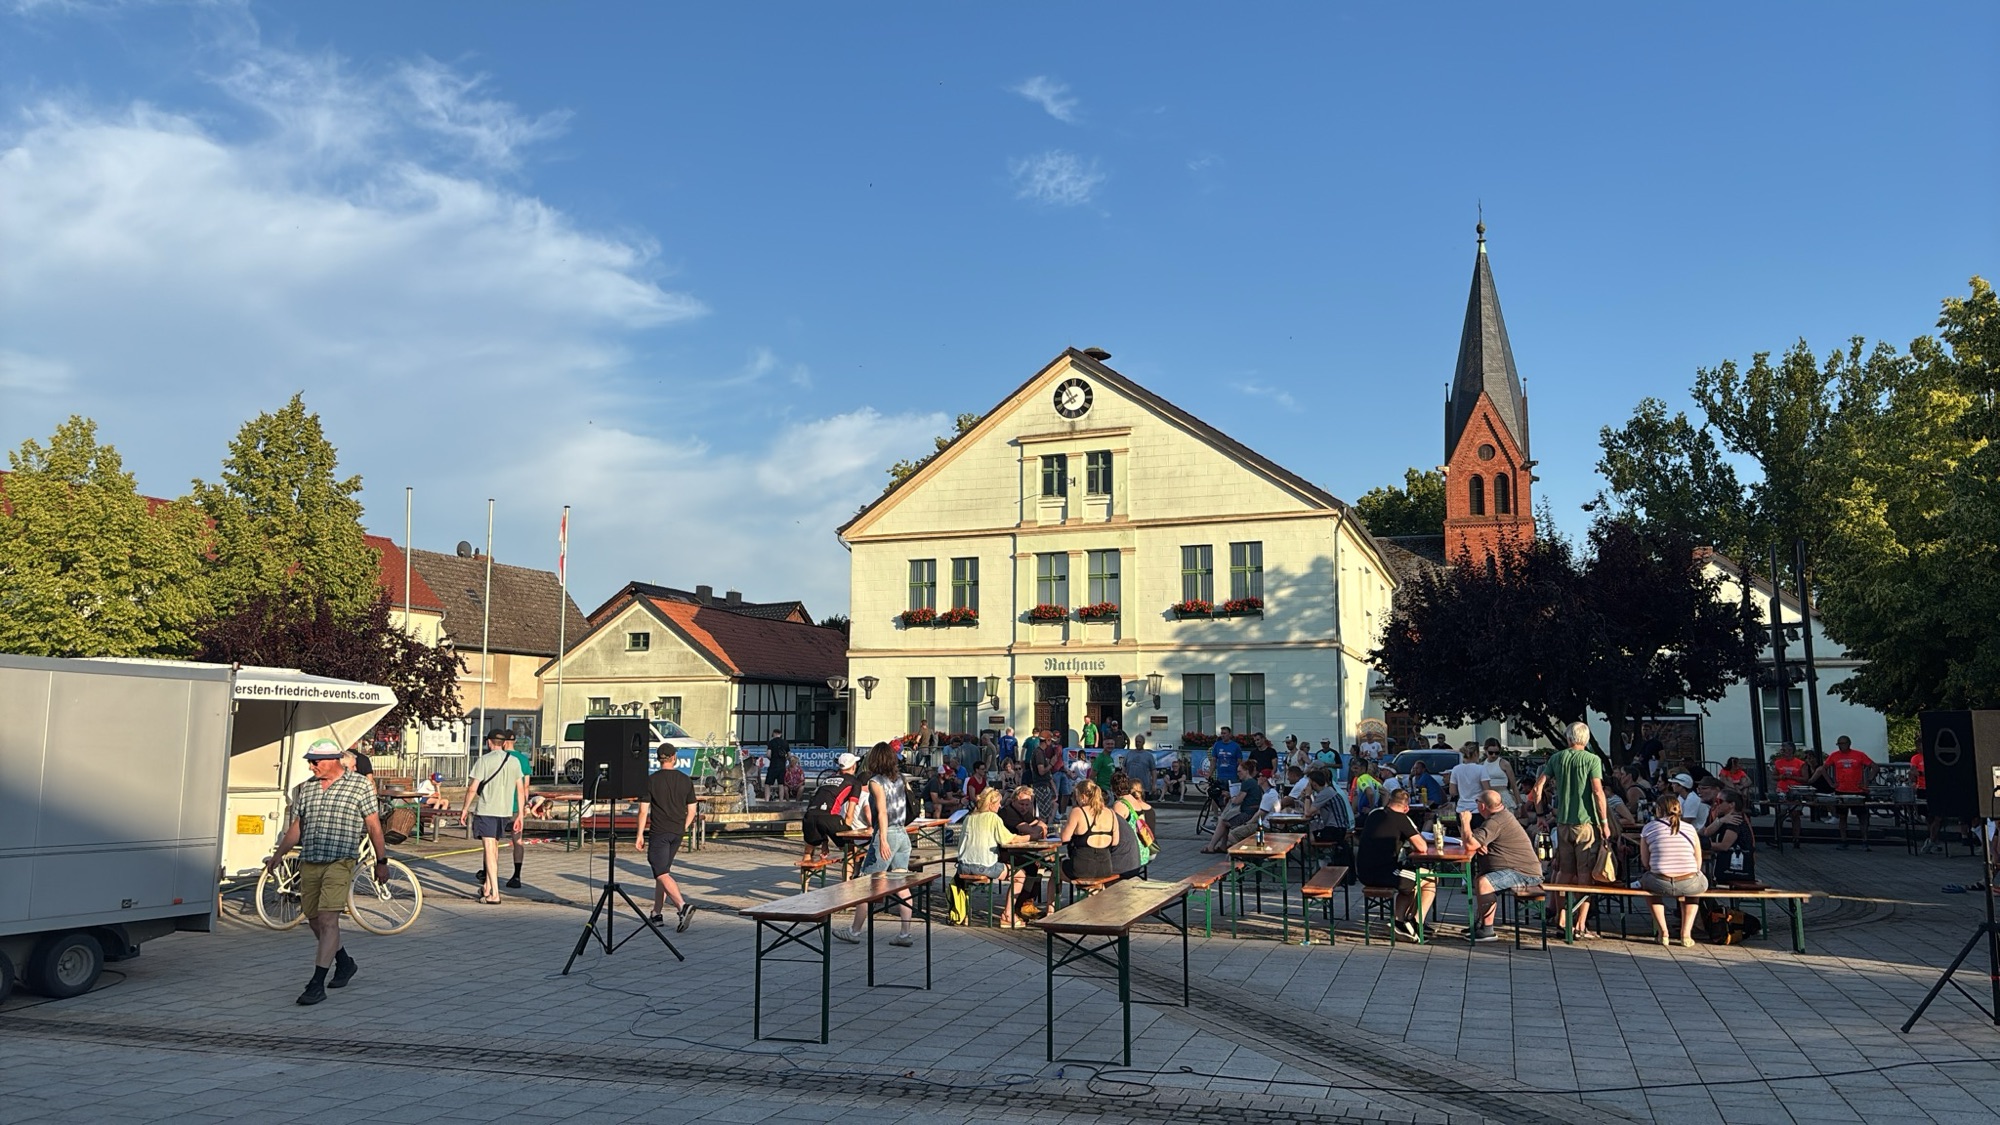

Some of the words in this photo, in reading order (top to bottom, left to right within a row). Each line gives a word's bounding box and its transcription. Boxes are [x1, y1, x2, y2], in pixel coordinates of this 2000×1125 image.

[1044, 657, 1105, 675] Rathaus
[235, 685, 380, 701] ersten-friedrich-events.com
[1125, 690, 1136, 707] 3
